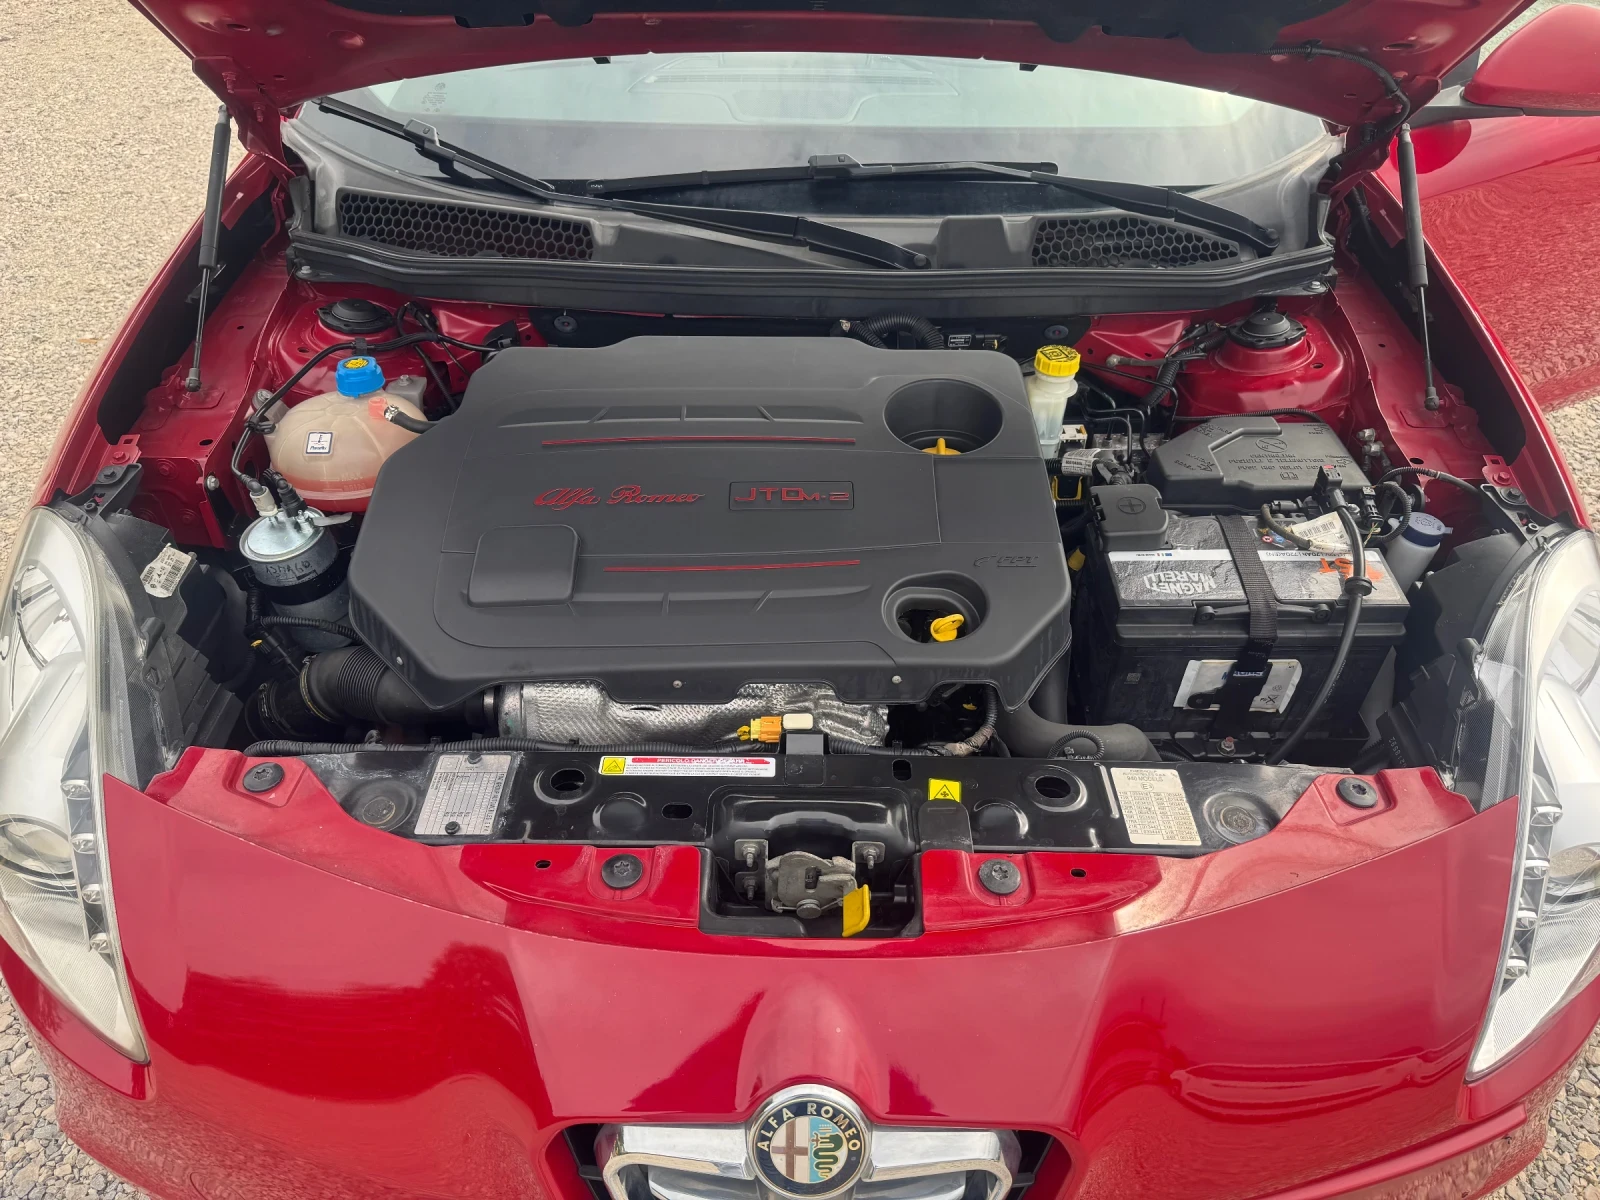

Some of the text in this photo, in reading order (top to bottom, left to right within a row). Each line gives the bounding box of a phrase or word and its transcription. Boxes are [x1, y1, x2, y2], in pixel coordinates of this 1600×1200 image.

[533, 484, 704, 511] Alfa Romeo
[757, 1102, 861, 1152] ALFA ROMEO
